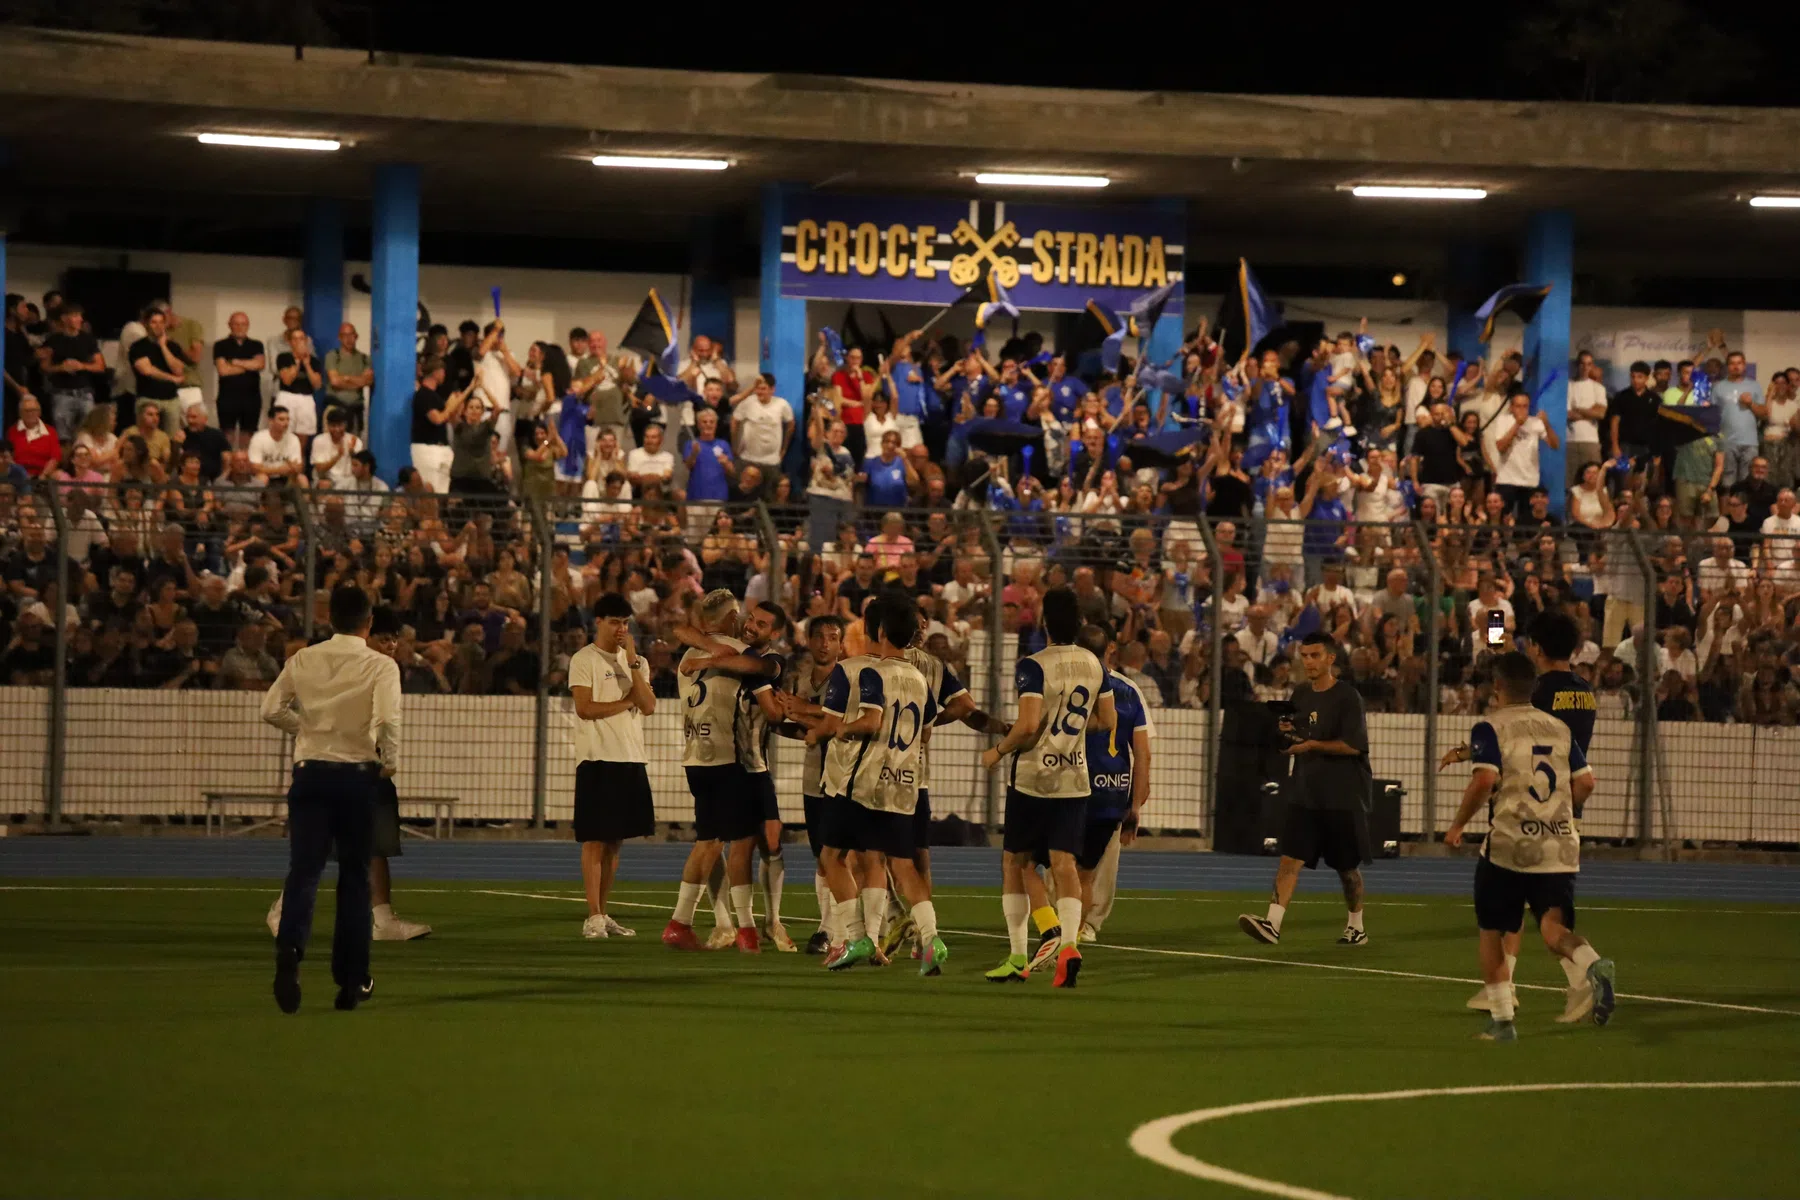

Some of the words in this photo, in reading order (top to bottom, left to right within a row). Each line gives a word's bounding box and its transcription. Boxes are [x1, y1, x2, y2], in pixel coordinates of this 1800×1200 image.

[795, 219, 936, 278] CROCE
[1031, 230, 1168, 288] STRADA
[888, 698, 920, 752] 10
[1050, 684, 1090, 737] 18
[1042, 751, 1084, 768] ONIS
[1093, 773, 1130, 788] ONIS
[1528, 745, 1557, 803] 5
[1520, 819, 1572, 836] ONIS
